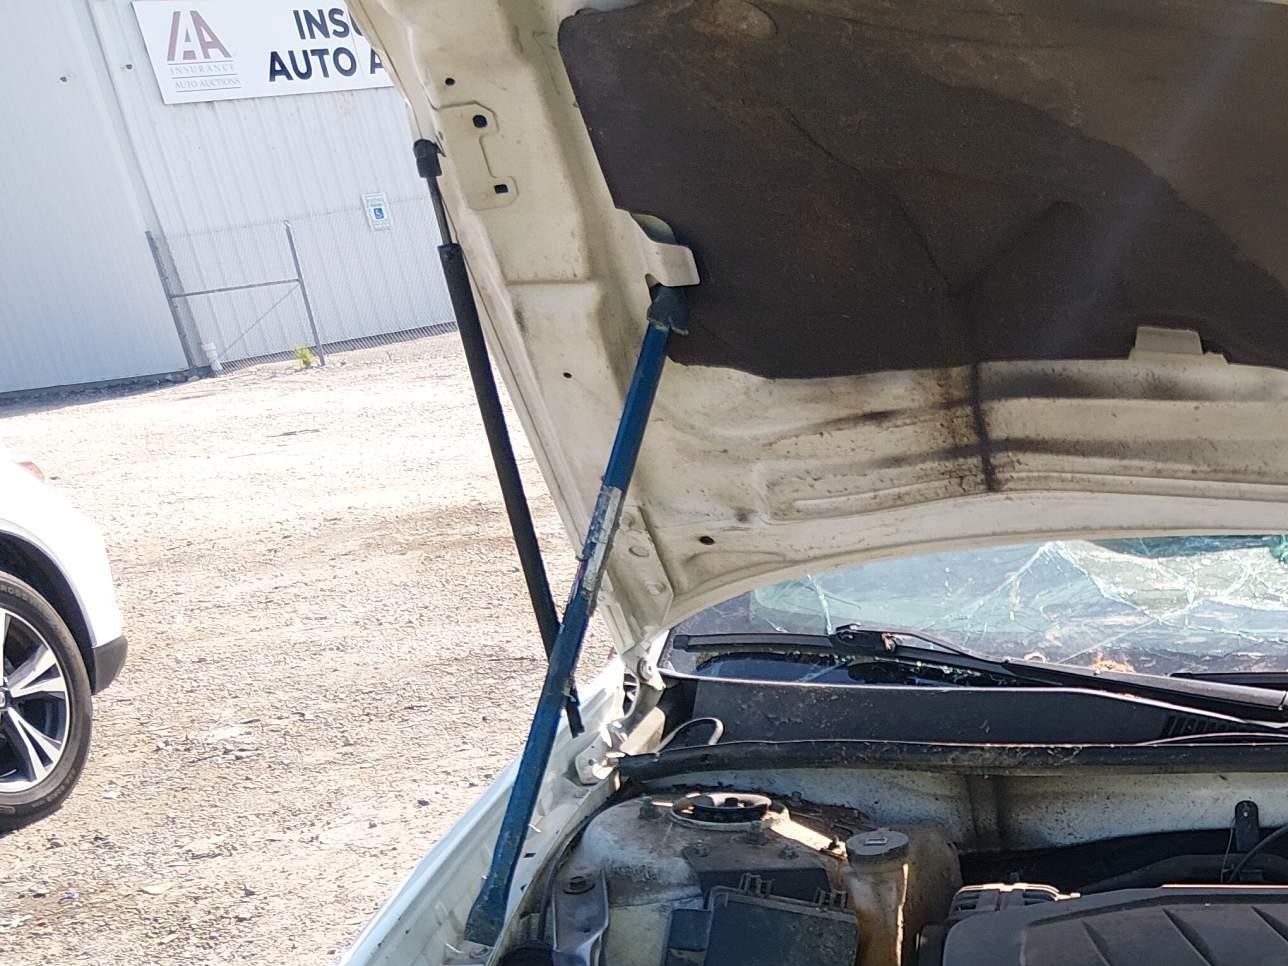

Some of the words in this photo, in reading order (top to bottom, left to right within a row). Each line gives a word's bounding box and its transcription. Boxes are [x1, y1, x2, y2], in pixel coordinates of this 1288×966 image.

[169, 64, 236, 76] INSURANCE
[268, 46, 357, 82] AUTO
[174, 79, 199, 89] AUTO
[200, 77, 241, 88] AUCTIONS
